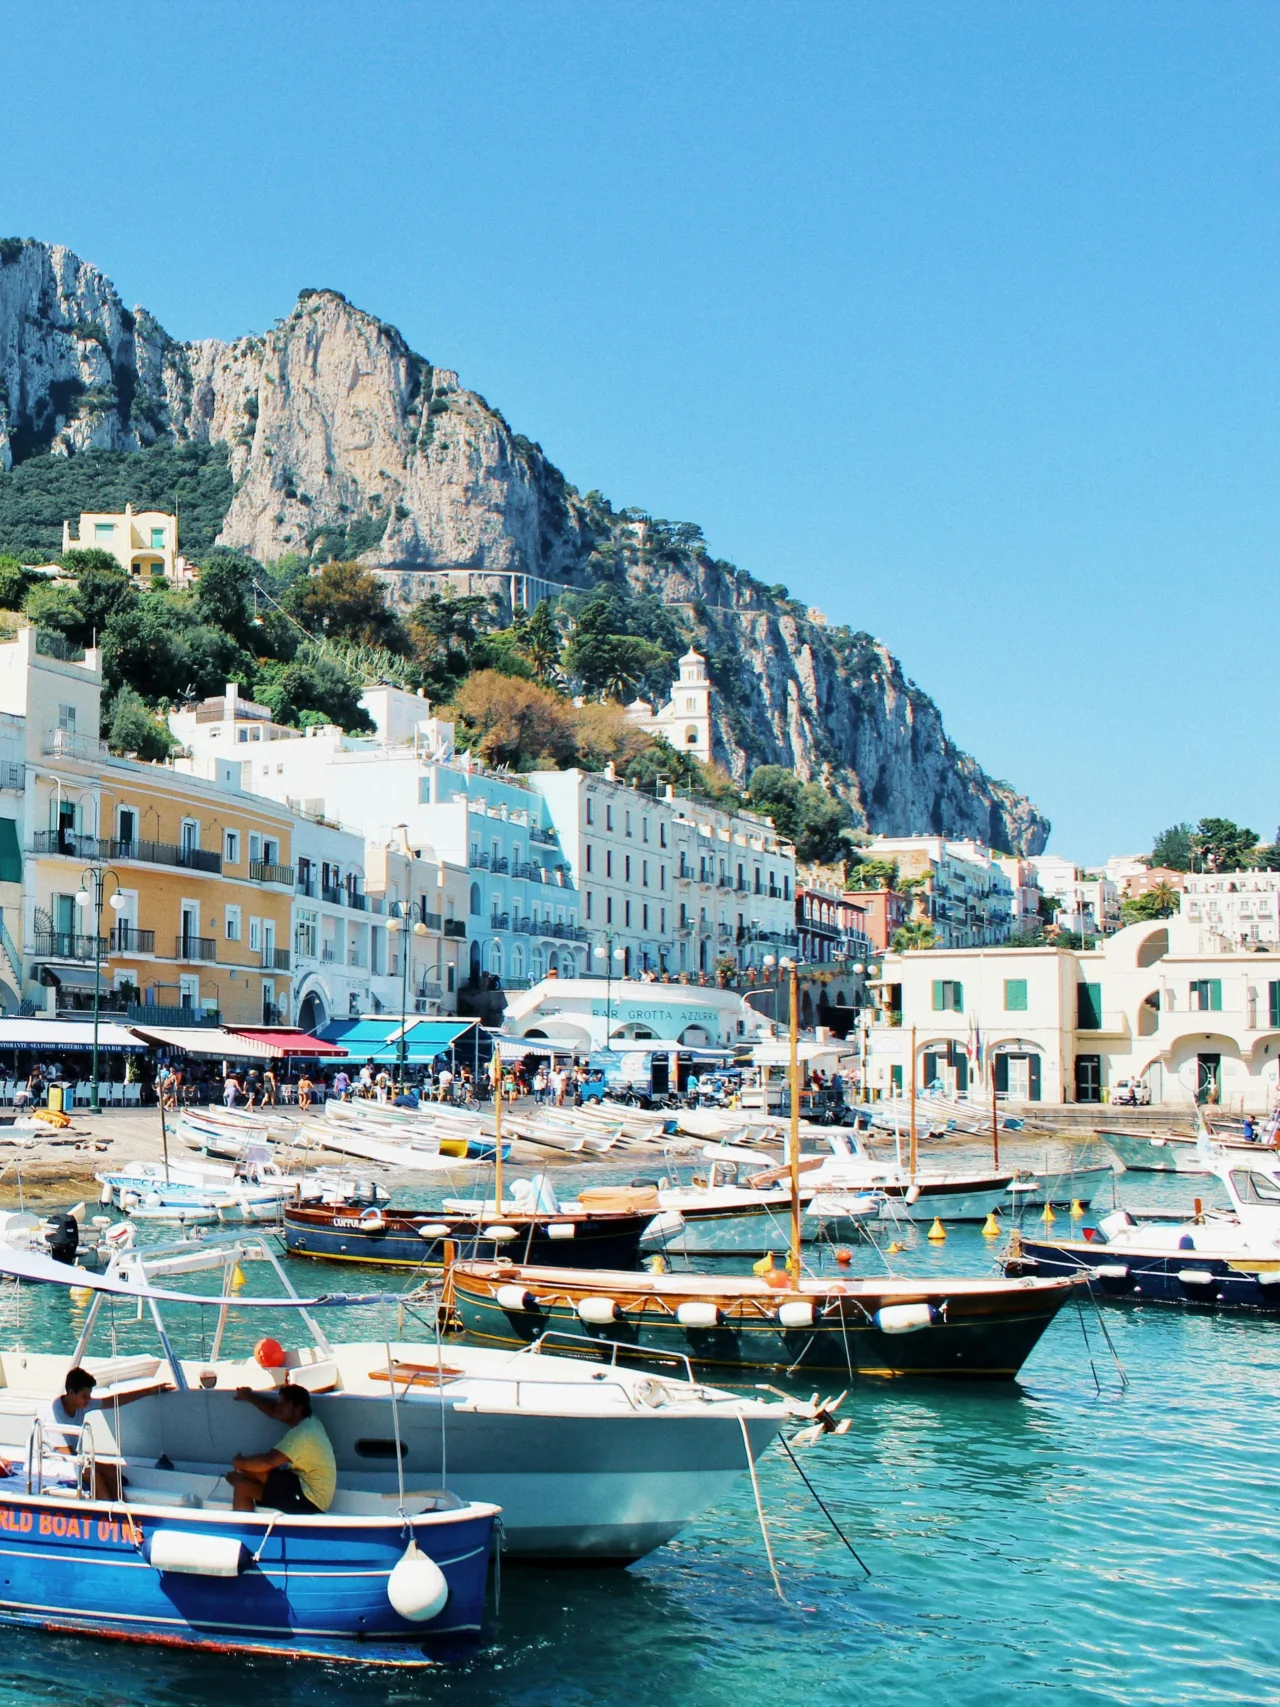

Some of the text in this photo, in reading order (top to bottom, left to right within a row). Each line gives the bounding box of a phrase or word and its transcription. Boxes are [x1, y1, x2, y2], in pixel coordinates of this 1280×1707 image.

[592, 1009, 718, 1021] BAR GROTTA AZZURRA
[39, 1512, 94, 1541] BOAT
